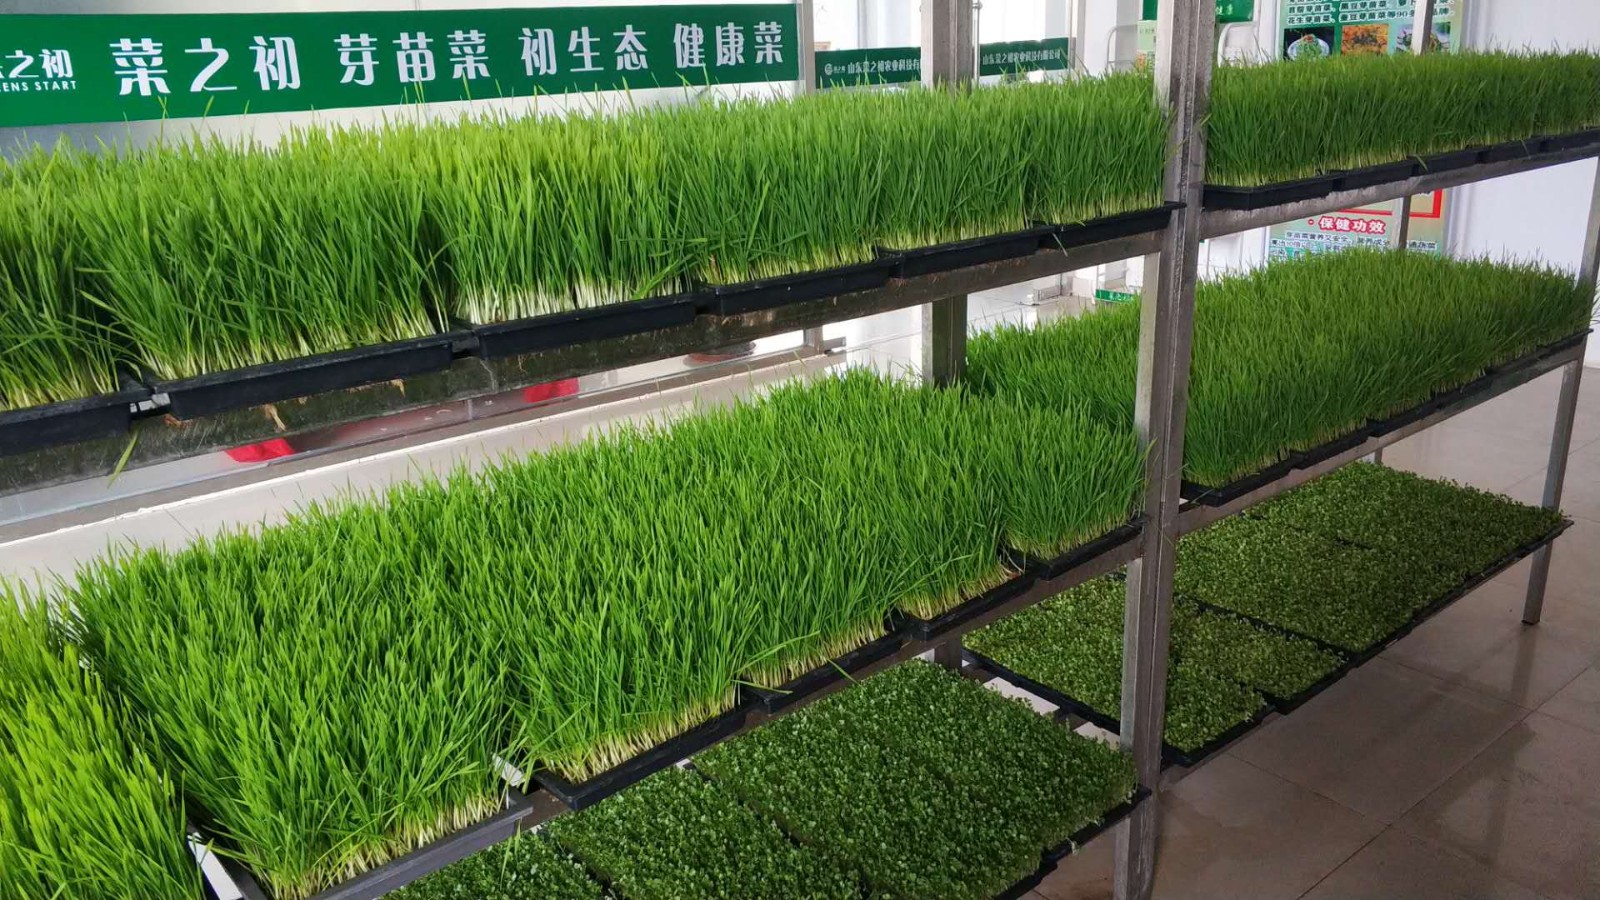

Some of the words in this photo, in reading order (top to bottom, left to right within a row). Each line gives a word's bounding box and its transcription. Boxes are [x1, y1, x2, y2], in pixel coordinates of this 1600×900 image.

[0, 49, 74, 79] 之初
[110, 36, 301, 96] 菜之初
[334, 30, 490, 86] 芽苗菜
[519, 24, 649, 77] 初生态
[674, 21, 785, 69] 健康菜
[847, 58, 921, 74] 山东菜之初农业科技有
[0, 82, 29, 93] ENS
[34, 80, 77, 92] START
[1319, 217, 1386, 234] 保健功效
